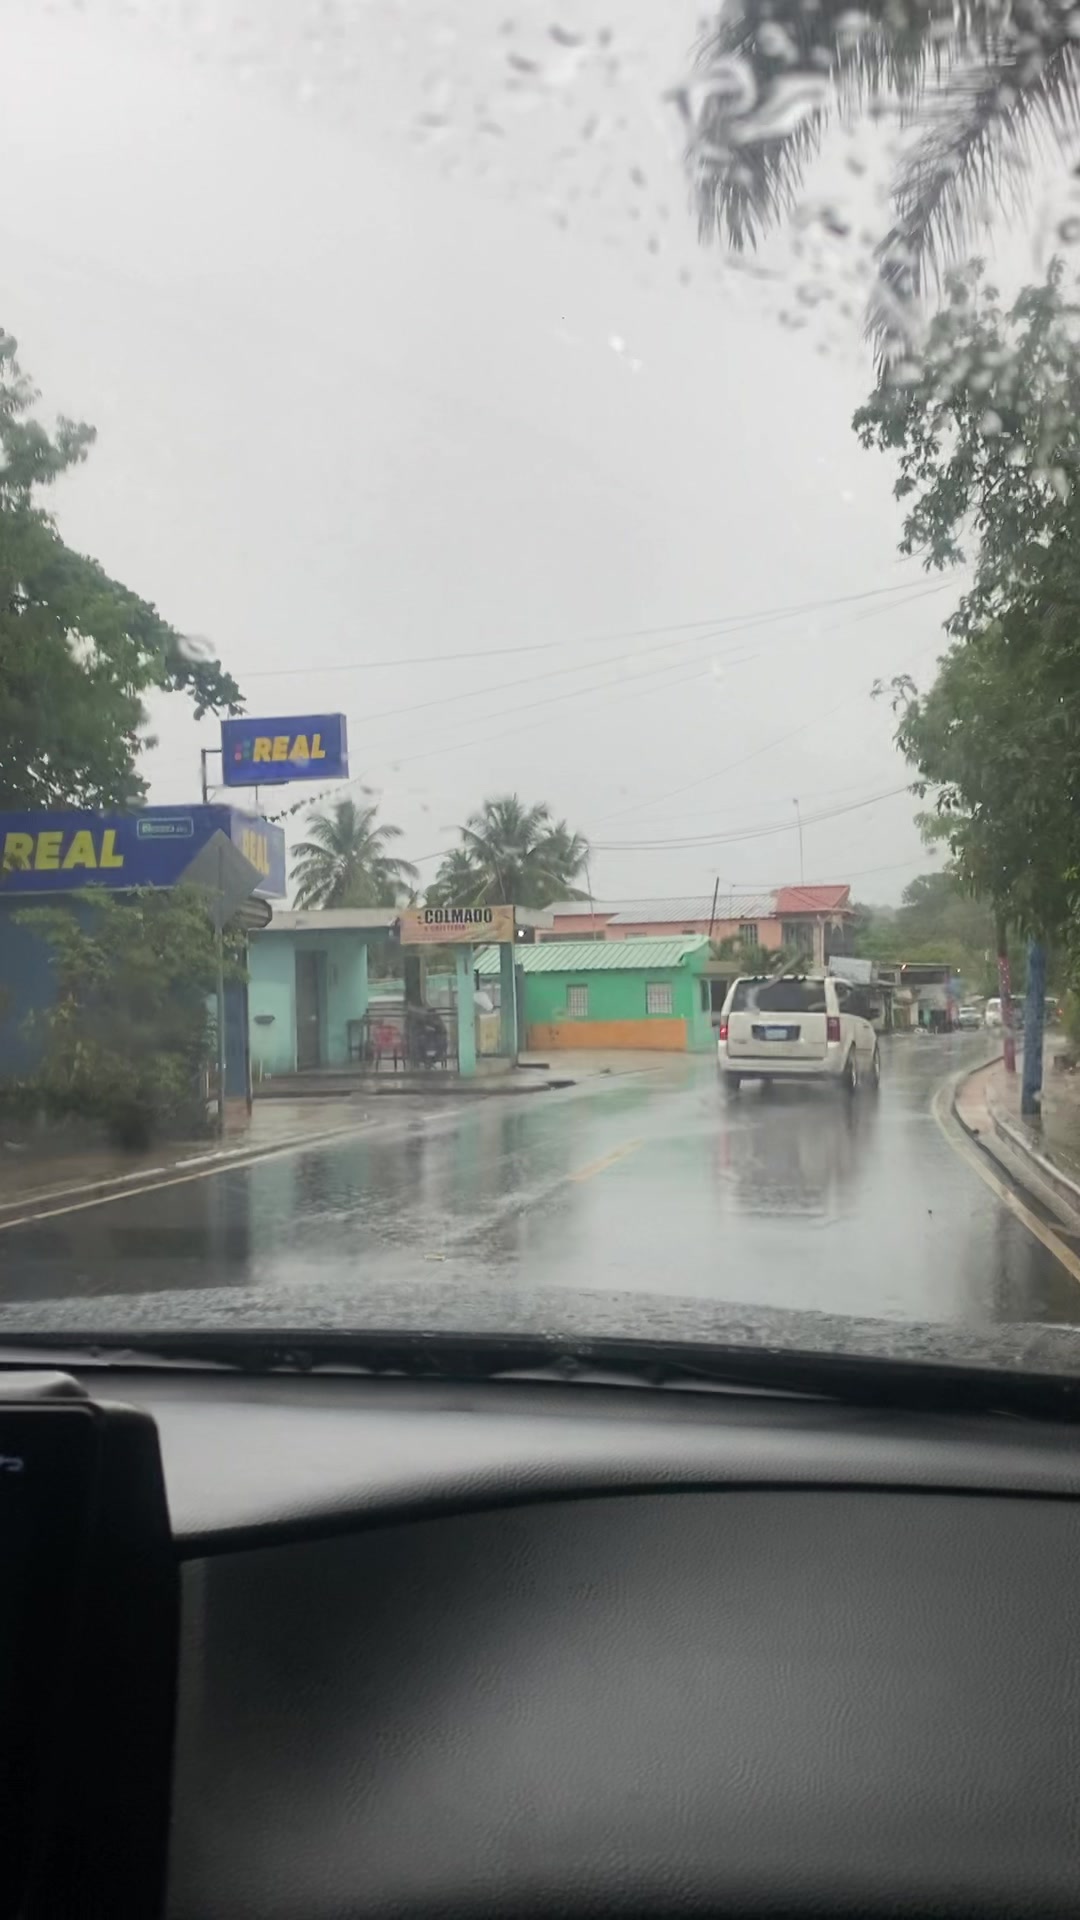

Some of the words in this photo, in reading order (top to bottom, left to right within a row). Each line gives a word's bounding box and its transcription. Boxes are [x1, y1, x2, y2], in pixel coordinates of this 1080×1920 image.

[252, 733, 326, 763] REAL
[3, 830, 123, 870] REAL
[425, 908, 492, 924] COLMADO
